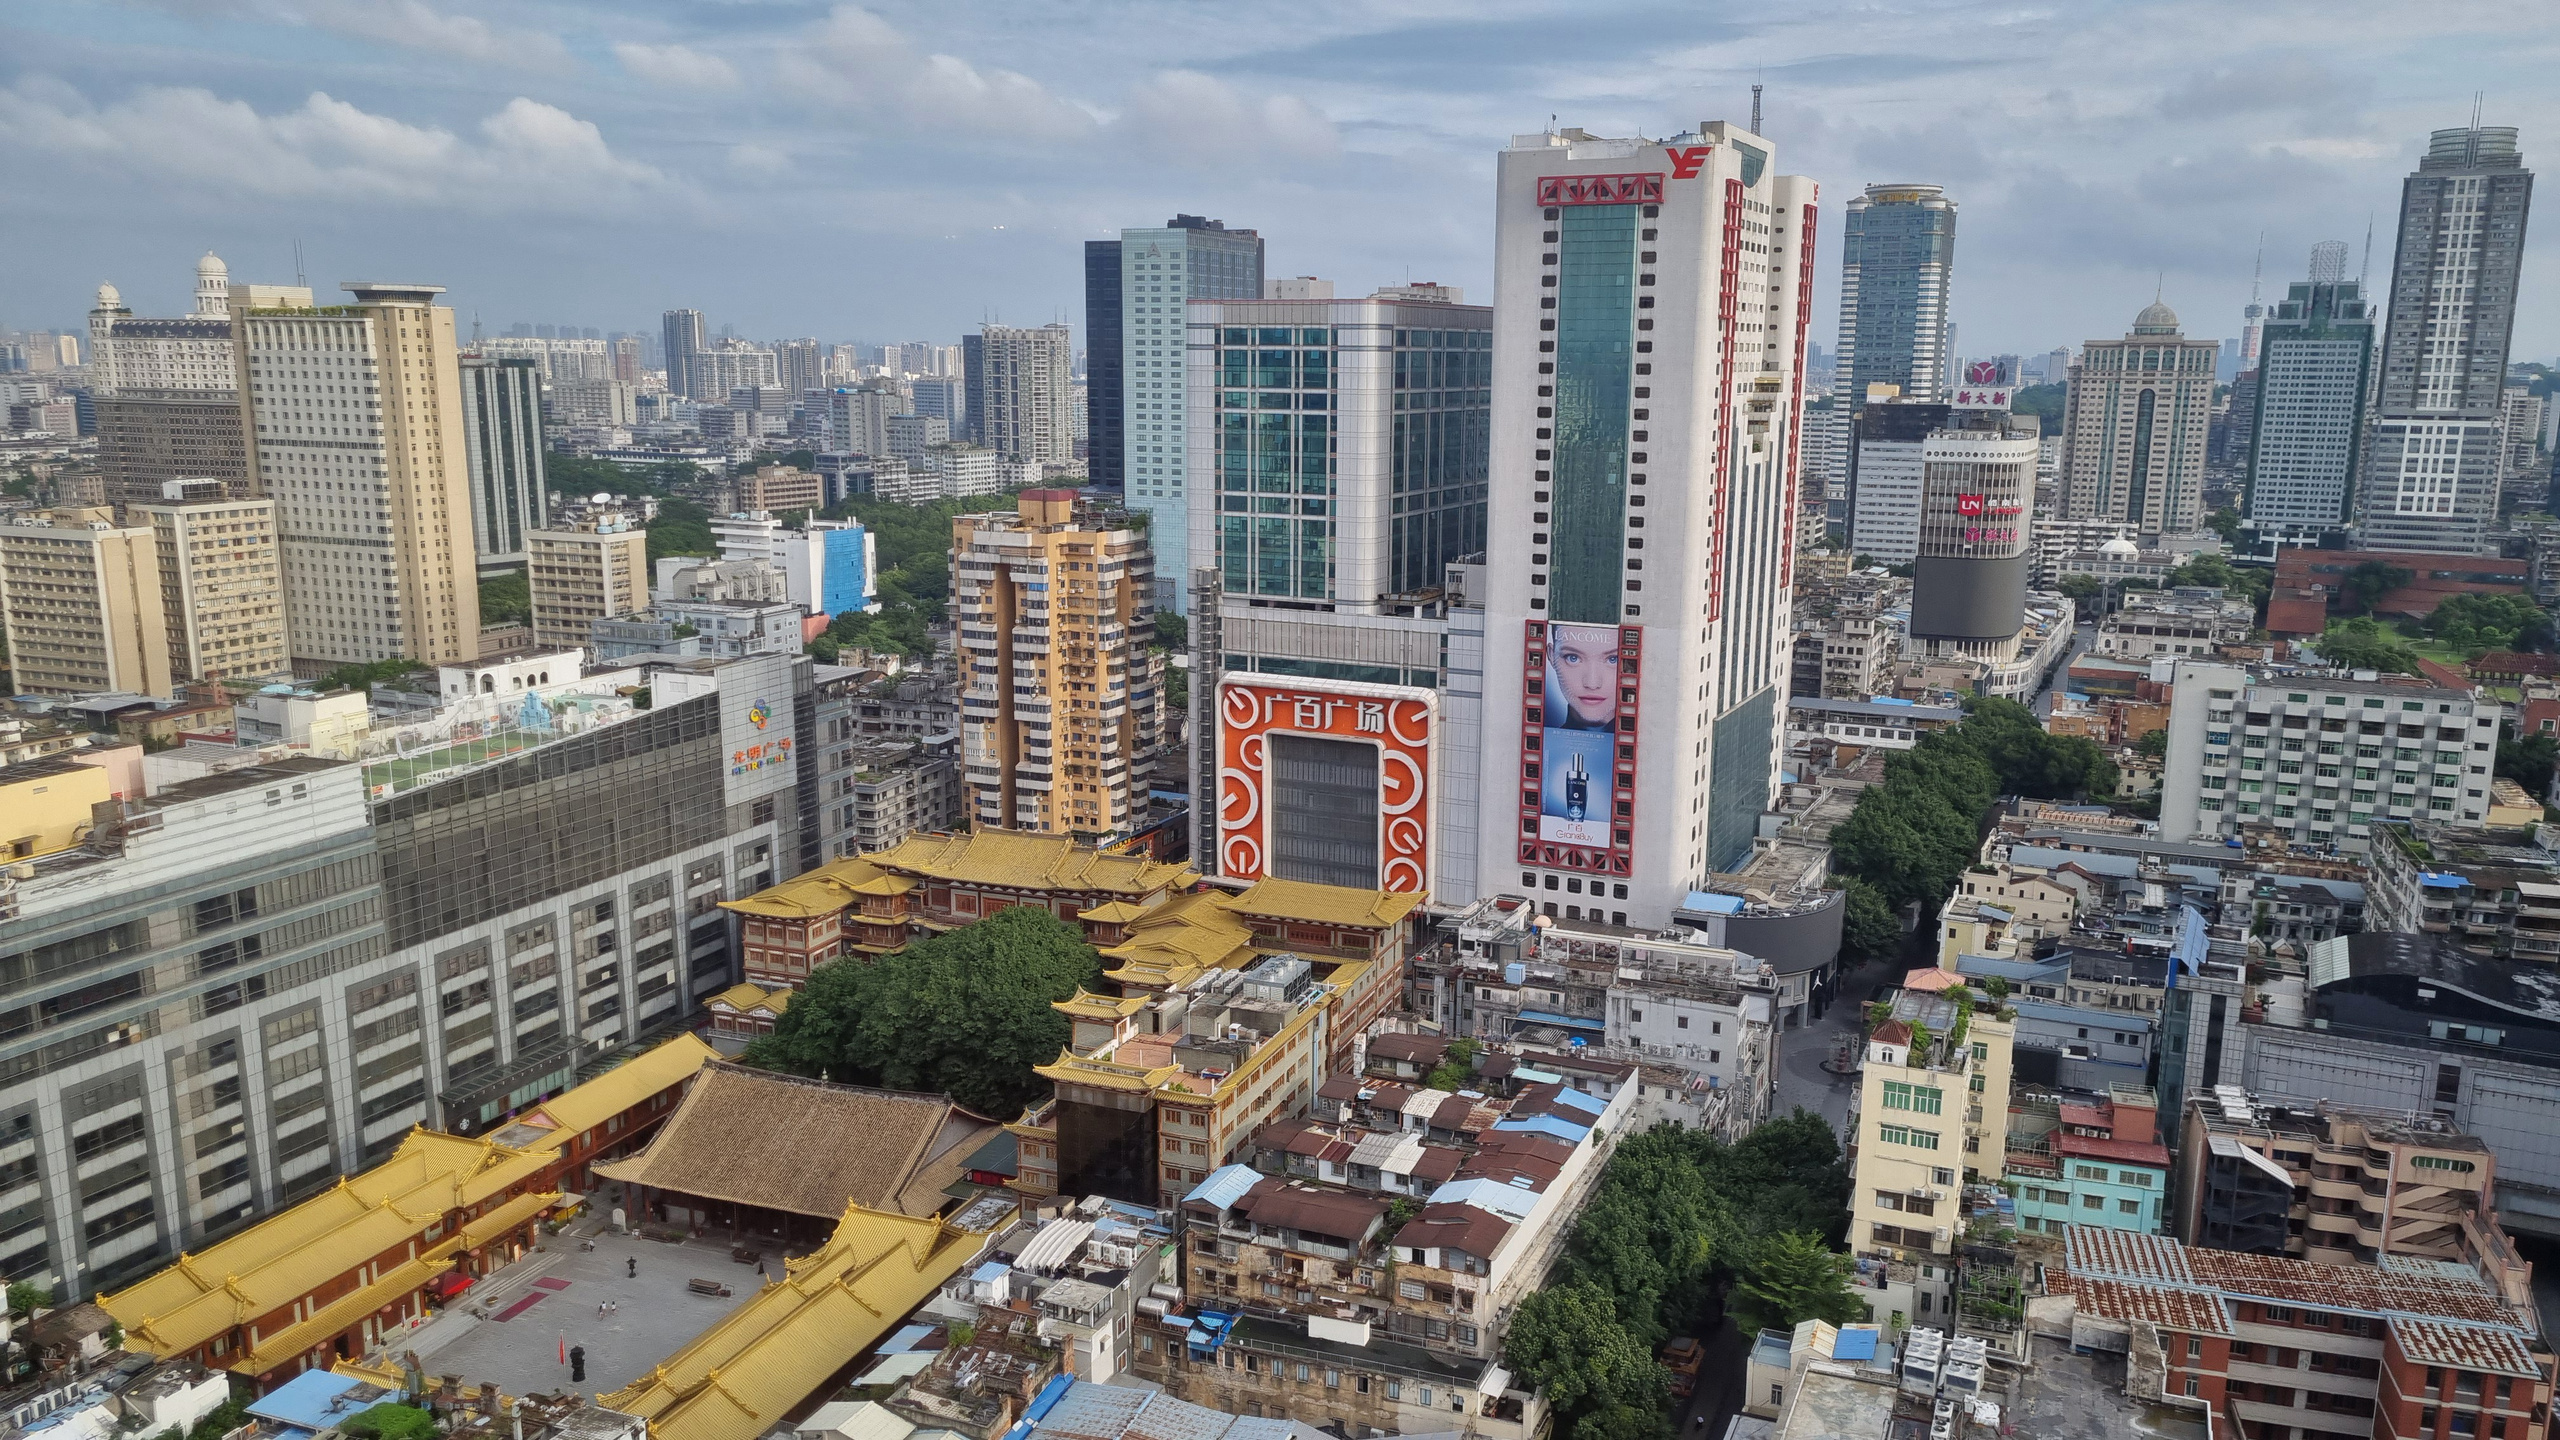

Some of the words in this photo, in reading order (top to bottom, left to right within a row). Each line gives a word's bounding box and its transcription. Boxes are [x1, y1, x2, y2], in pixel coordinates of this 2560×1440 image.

[1957, 390, 2007, 405] 新大新
[1264, 693, 1386, 734] 广百广场
[732, 737, 792, 764] 光明广场
[731, 760, 763, 776] METRO
